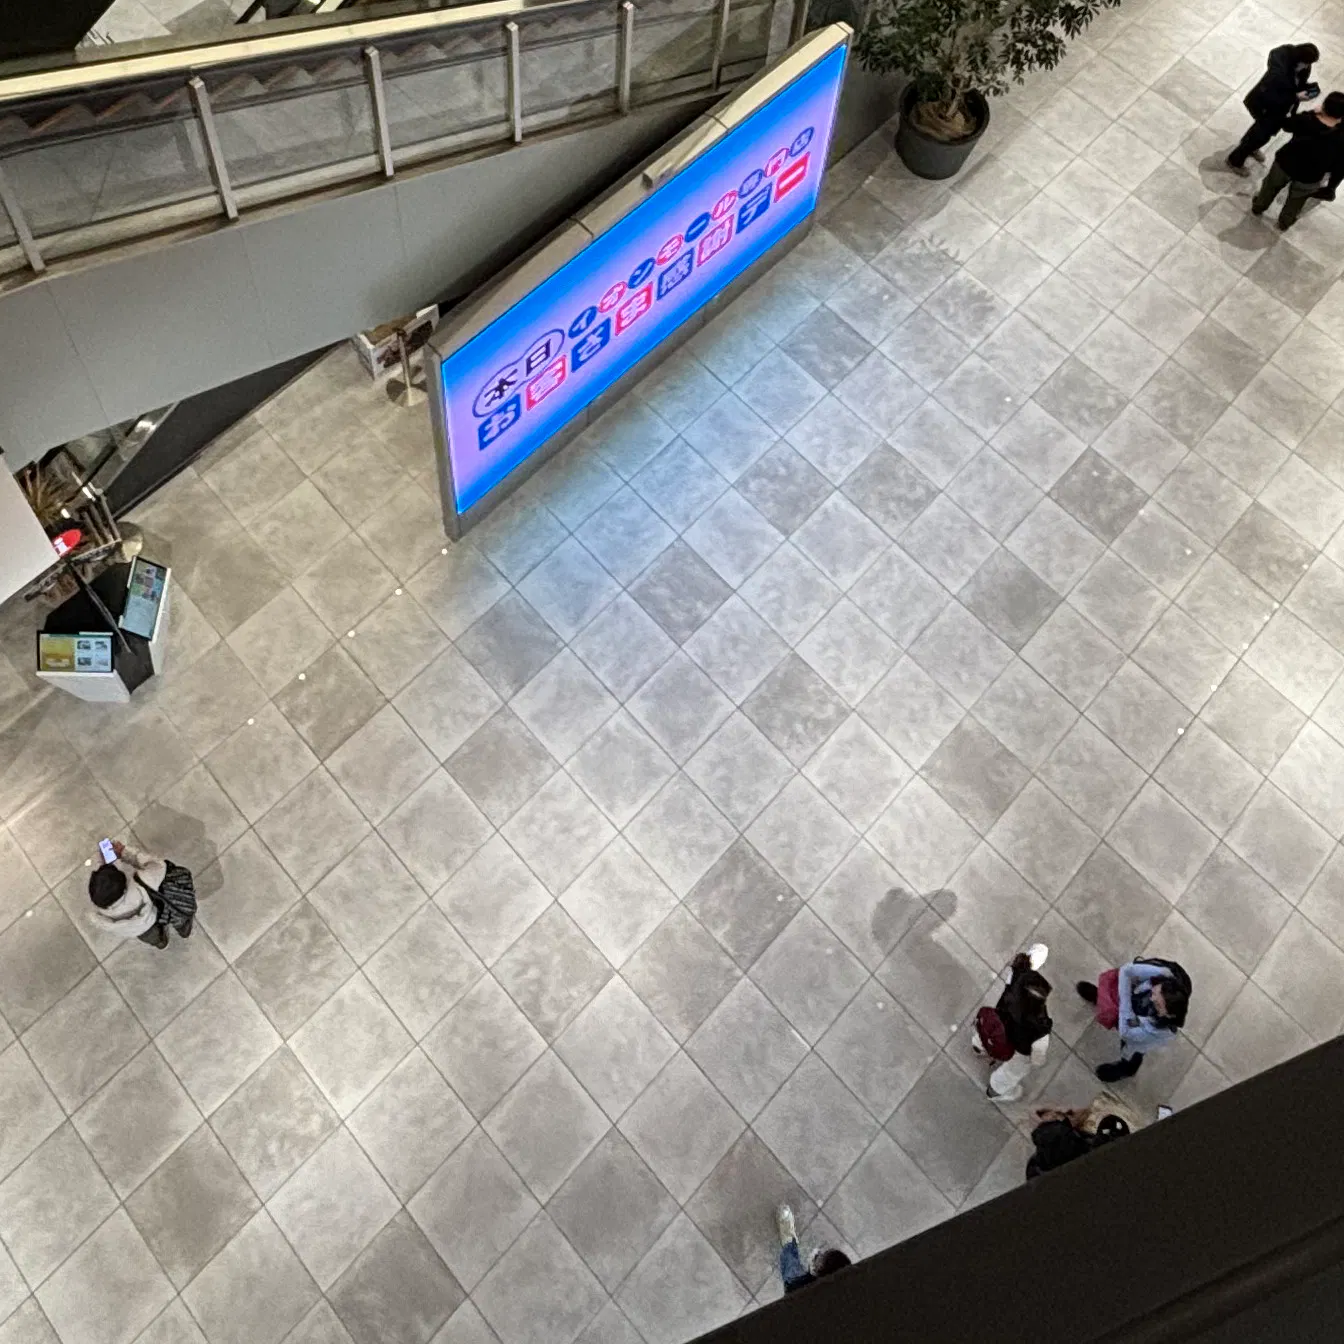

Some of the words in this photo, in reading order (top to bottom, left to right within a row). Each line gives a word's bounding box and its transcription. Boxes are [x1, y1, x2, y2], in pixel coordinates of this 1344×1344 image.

[482, 157, 804, 444] お客さま感謝デー
[484, 338, 550, 410] 本日
